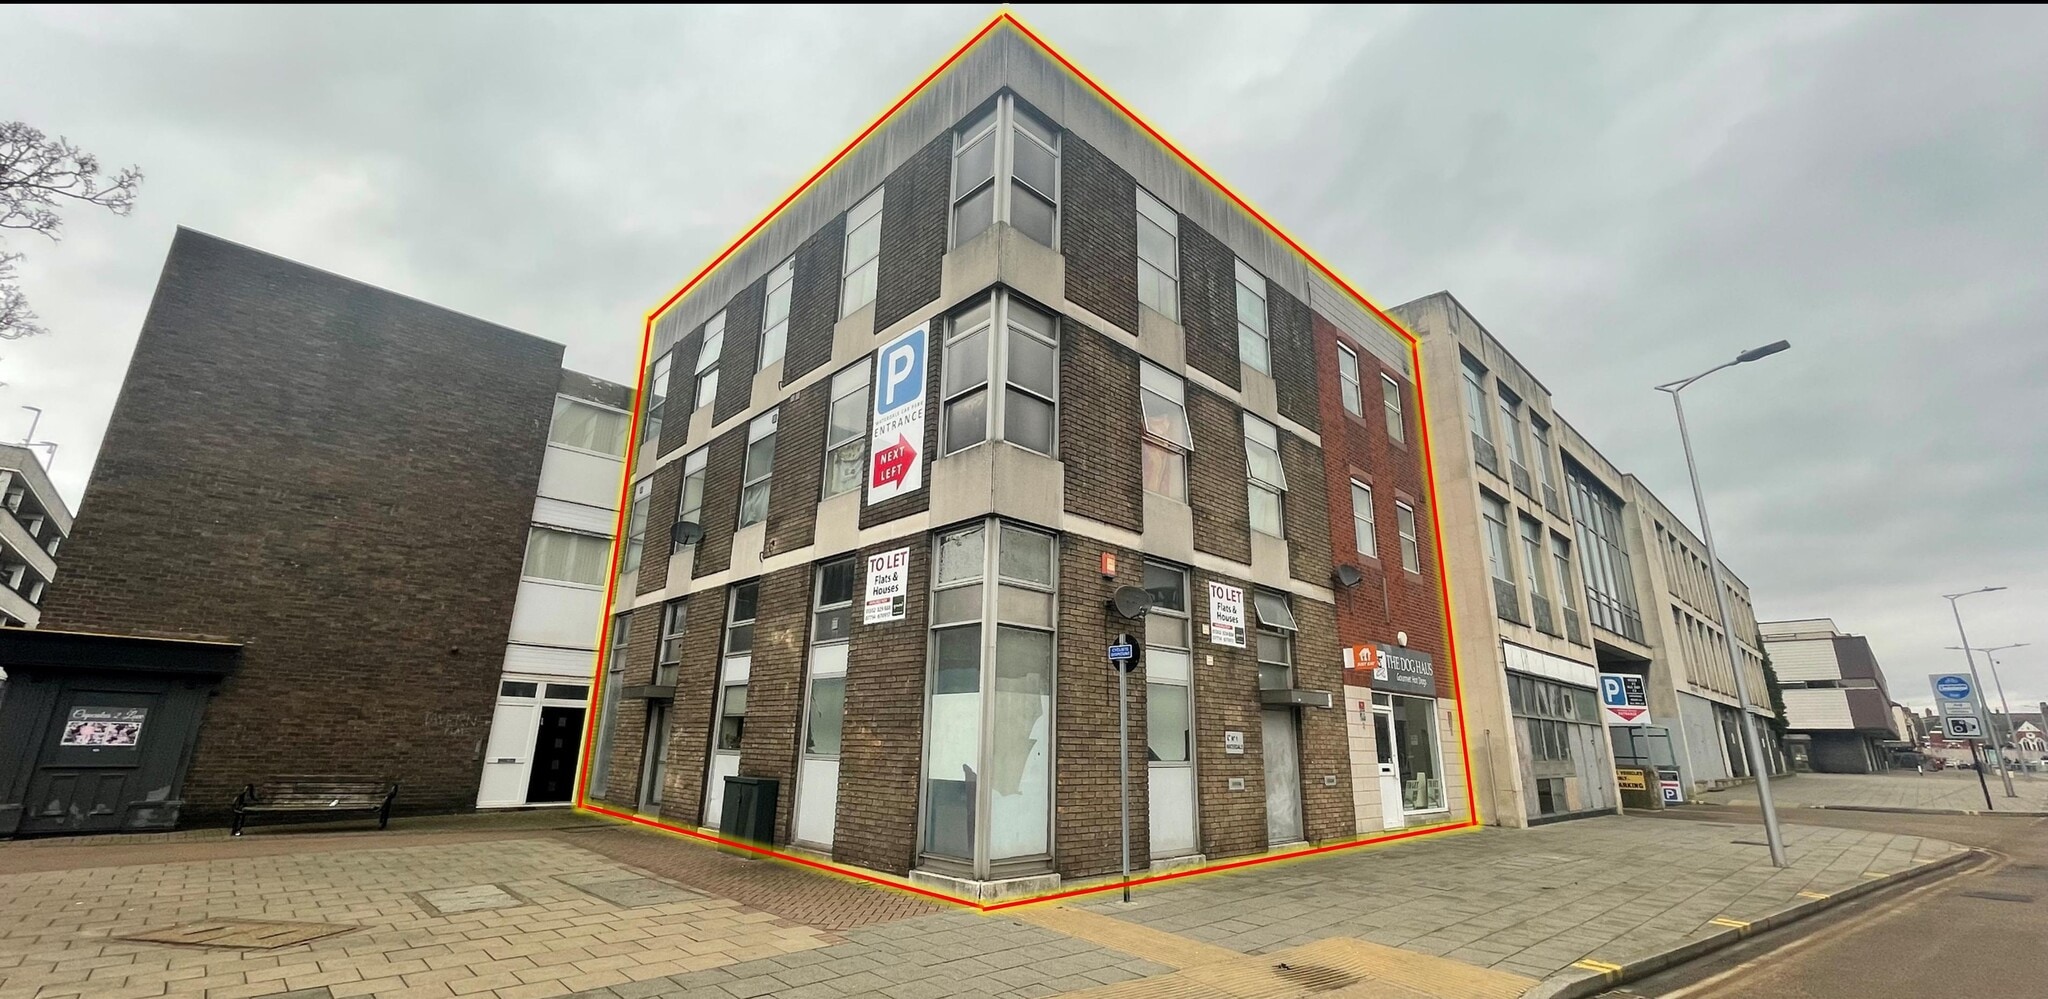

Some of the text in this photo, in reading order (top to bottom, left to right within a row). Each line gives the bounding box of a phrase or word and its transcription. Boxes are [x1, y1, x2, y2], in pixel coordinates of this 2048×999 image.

[886, 344, 915, 406] P
[901, 406, 911, 416] CAR
[911, 401, 924, 410] PARK
[874, 408, 923, 438] ENTRANCE
[880, 446, 905, 465] NEXT
[880, 463, 903, 481] LEFT
[870, 551, 907, 573] TO LET
[874, 571, 898, 586] Flats &
[873, 584, 899, 596] Houses
[1211, 584, 1241, 603] TO LET
[1217, 602, 1237, 614] Flats &
[1217, 612, 1239, 624] Houses
[1386, 654, 1434, 676] THE DOG HAUS
[1396, 672, 1412, 682] Gourmet
[1604, 679, 1620, 703] P
[1665, 789, 1675, 799] P
